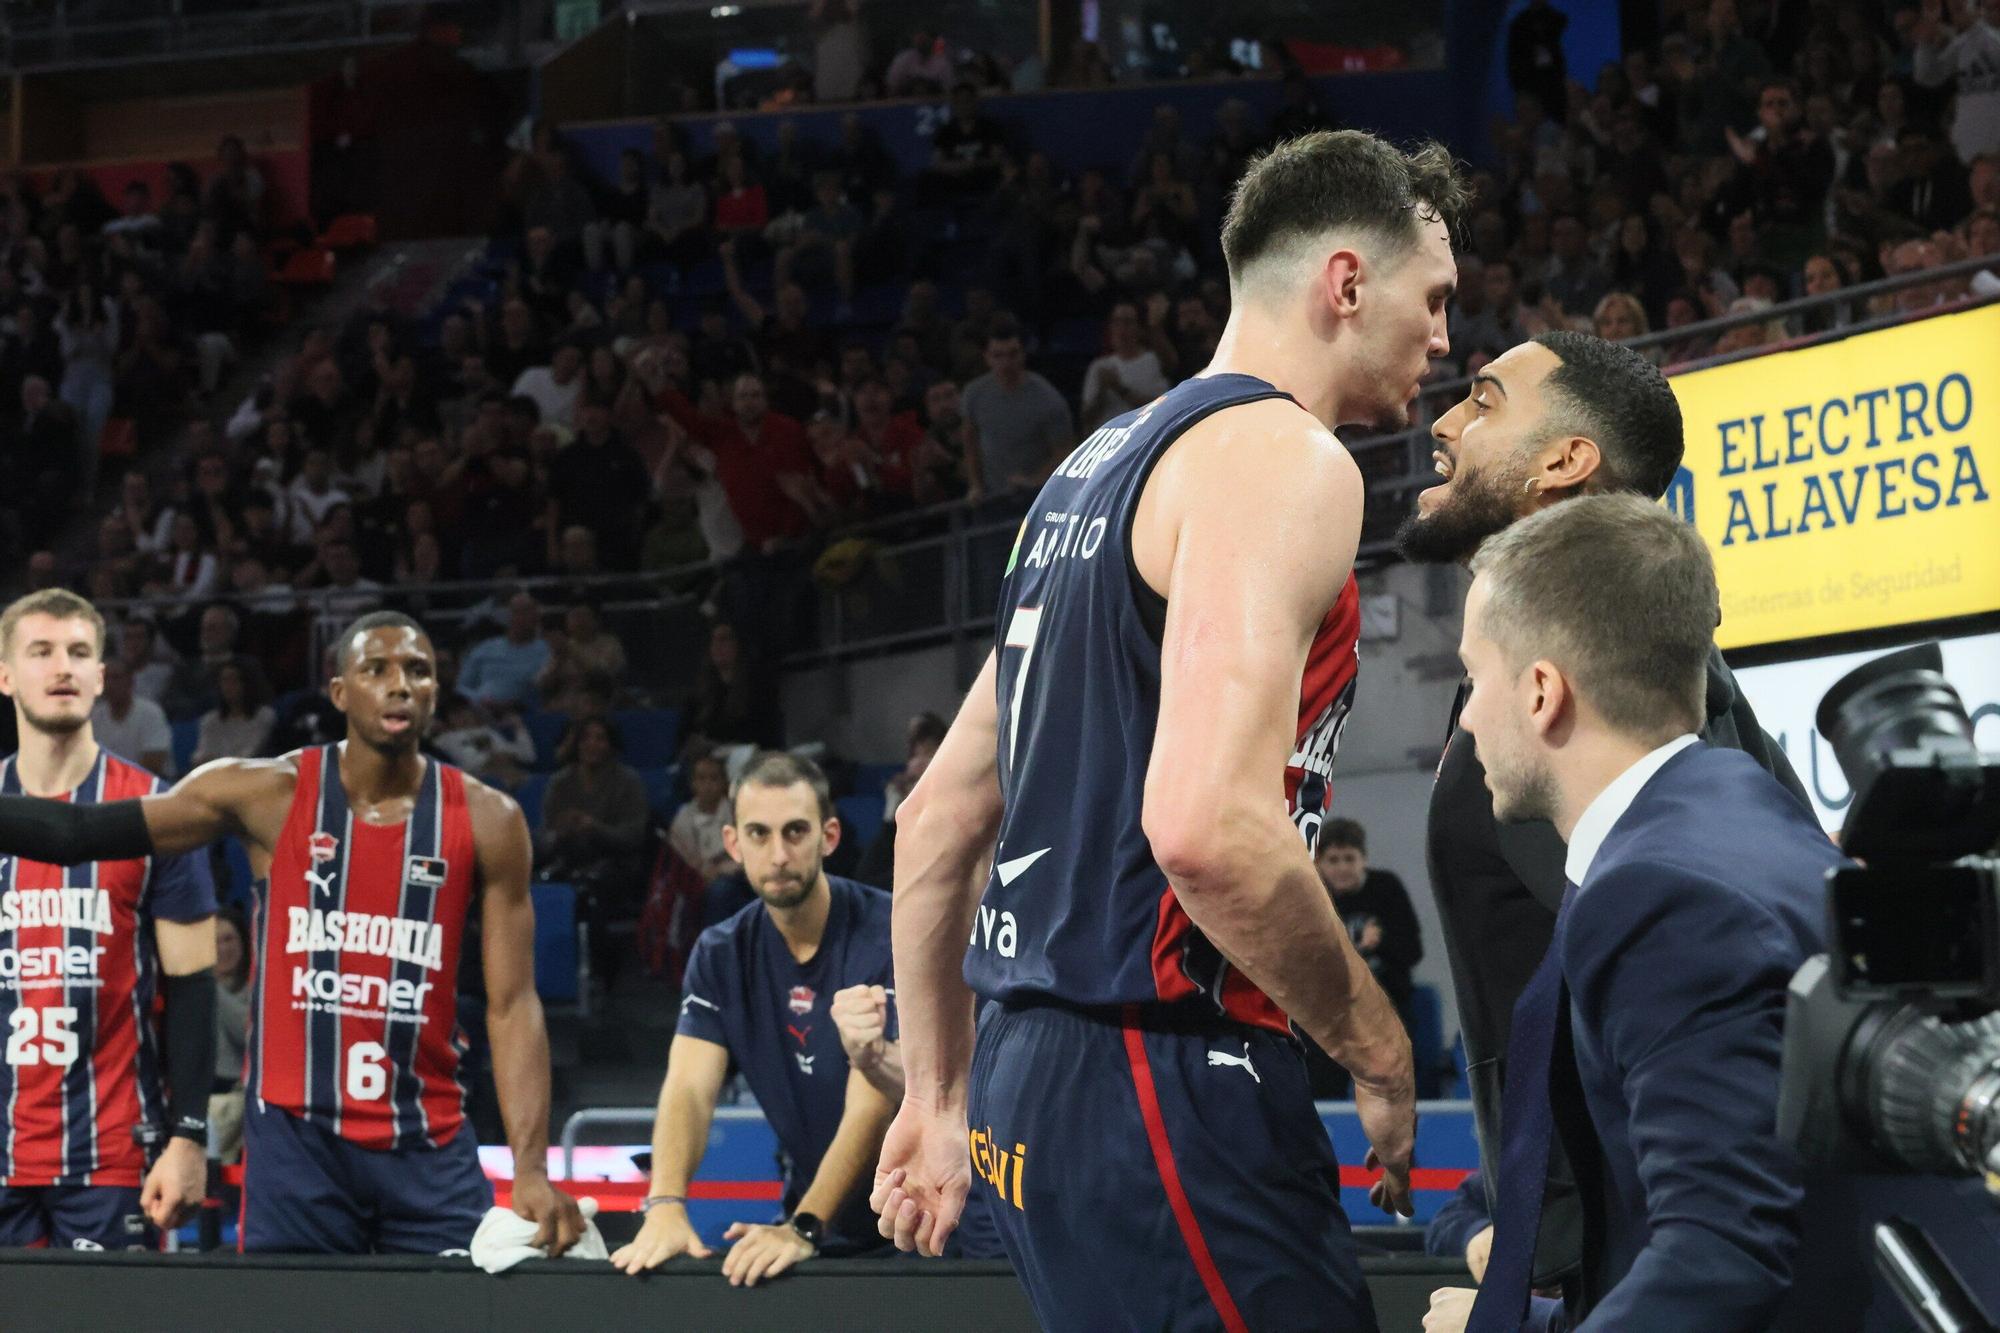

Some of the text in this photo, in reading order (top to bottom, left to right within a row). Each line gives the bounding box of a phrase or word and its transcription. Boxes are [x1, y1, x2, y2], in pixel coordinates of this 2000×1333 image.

[1717, 372, 1973, 477] ELECTRO
[1721, 445, 1990, 546] ALAVESA
[1818, 571, 1845, 605] de
[1850, 552, 1963, 604] Seguridad
[0, 887, 114, 935] SKONIA
[285, 905, 443, 972] BASKONIA
[6, 1006, 79, 1067] 25
[346, 1041, 387, 1101] 6
